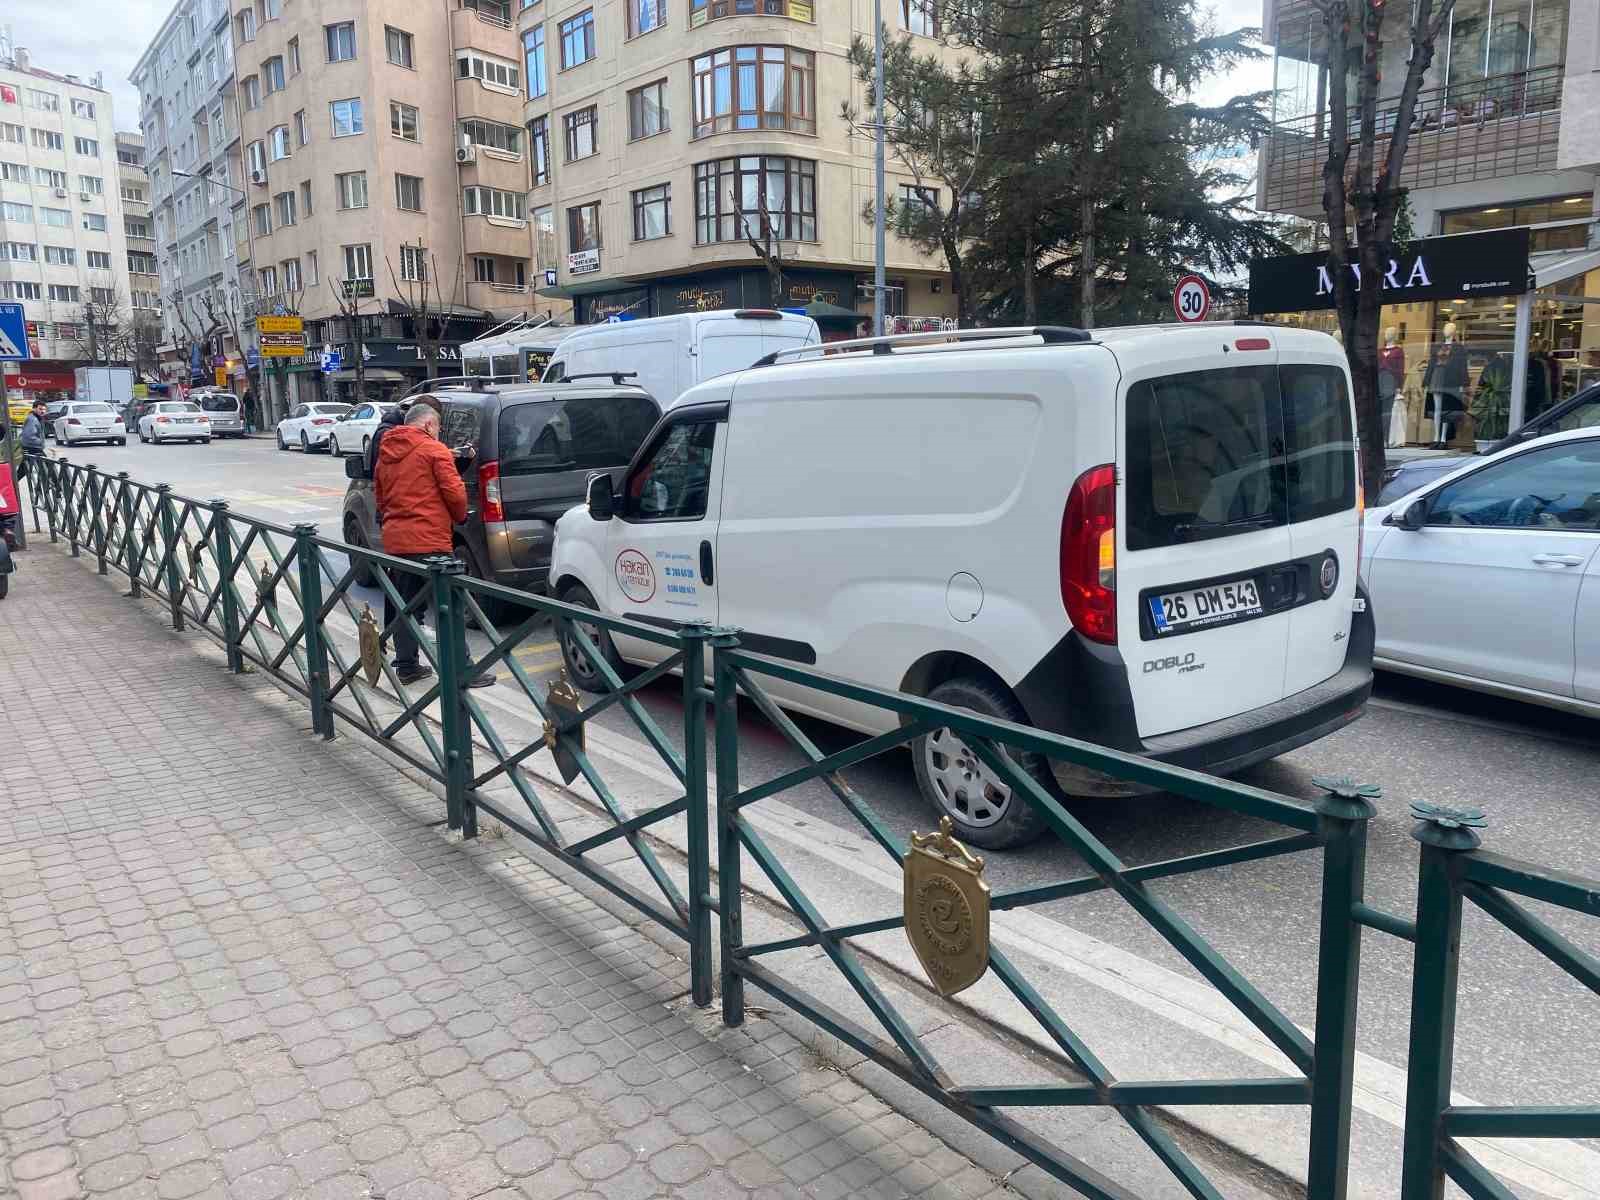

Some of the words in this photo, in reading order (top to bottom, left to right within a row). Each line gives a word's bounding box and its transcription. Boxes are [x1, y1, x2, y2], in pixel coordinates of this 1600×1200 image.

[1182, 290, 1202, 313] 30
[620, 559, 649, 576] Hakan
[1164, 597, 1188, 622] 26
[1193, 589, 1224, 616] DM
[1223, 582, 1259, 609] 543
[1142, 652, 1196, 674] DOBLO
